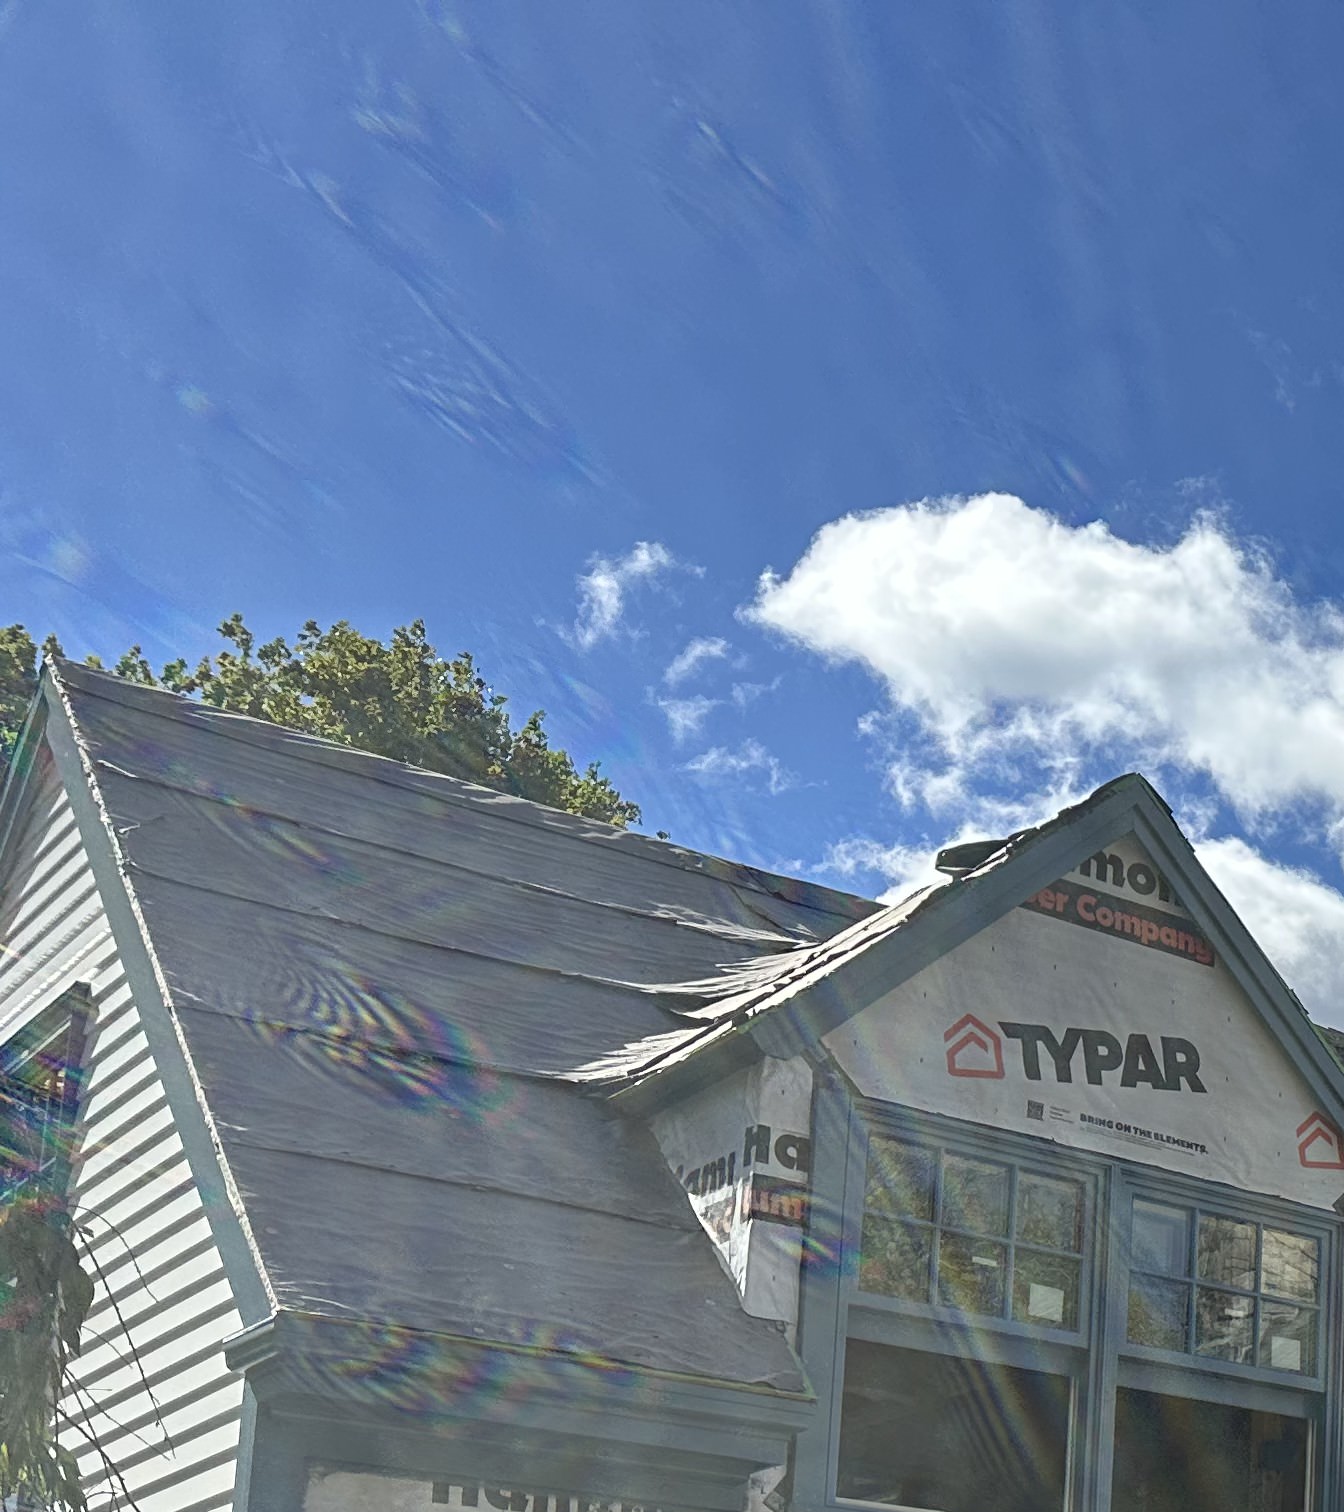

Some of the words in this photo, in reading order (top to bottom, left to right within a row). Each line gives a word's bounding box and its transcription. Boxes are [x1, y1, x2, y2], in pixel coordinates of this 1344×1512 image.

[1076, 893, 1213, 964] Company
[997, 1021, 1208, 1094] TYPAR
[1079, 1112, 1114, 1130] BRING
[1115, 1121, 1132, 1134] ON
[1133, 1126, 1152, 1140] THE
